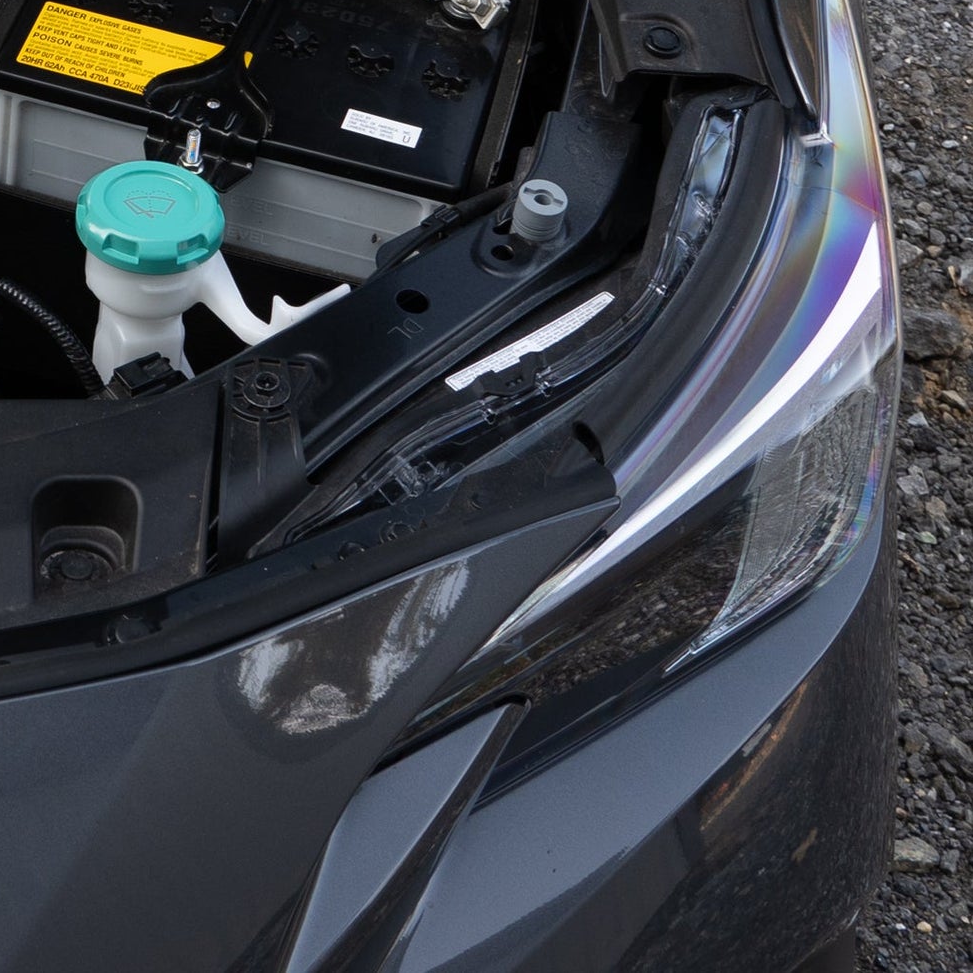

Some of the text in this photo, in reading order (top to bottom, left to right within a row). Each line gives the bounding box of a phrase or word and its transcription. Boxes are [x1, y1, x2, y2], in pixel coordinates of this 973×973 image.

[47, 5, 87, 20] DANGER
[89, 17, 120, 29] EXPLOSIVE
[122, 25, 142, 34] GASES
[32, 32, 72, 47] POISON
[74, 43, 98, 53] CAUSES
[100, 50, 121, 60] SEVERE
[123, 55, 143, 65] BURNS
[54, 29, 69, 38] VENT
[70, 32, 85, 41] CAPS
[87, 37, 104, 46] TIGHT
[106, 42, 119, 50] AND
[119, 45, 137, 55] LEVEL
[21, 55, 44, 66] 20HR
[44, 62, 65, 72] 62Ah
[68, 67, 88, 78] CCA
[90, 72, 109, 83] 470A
[25, 48, 41, 56] KEEP
[64, 58, 85, 68] REACH
[95, 65, 125, 78] CHILDREN
[402, 135, 411, 144] U
